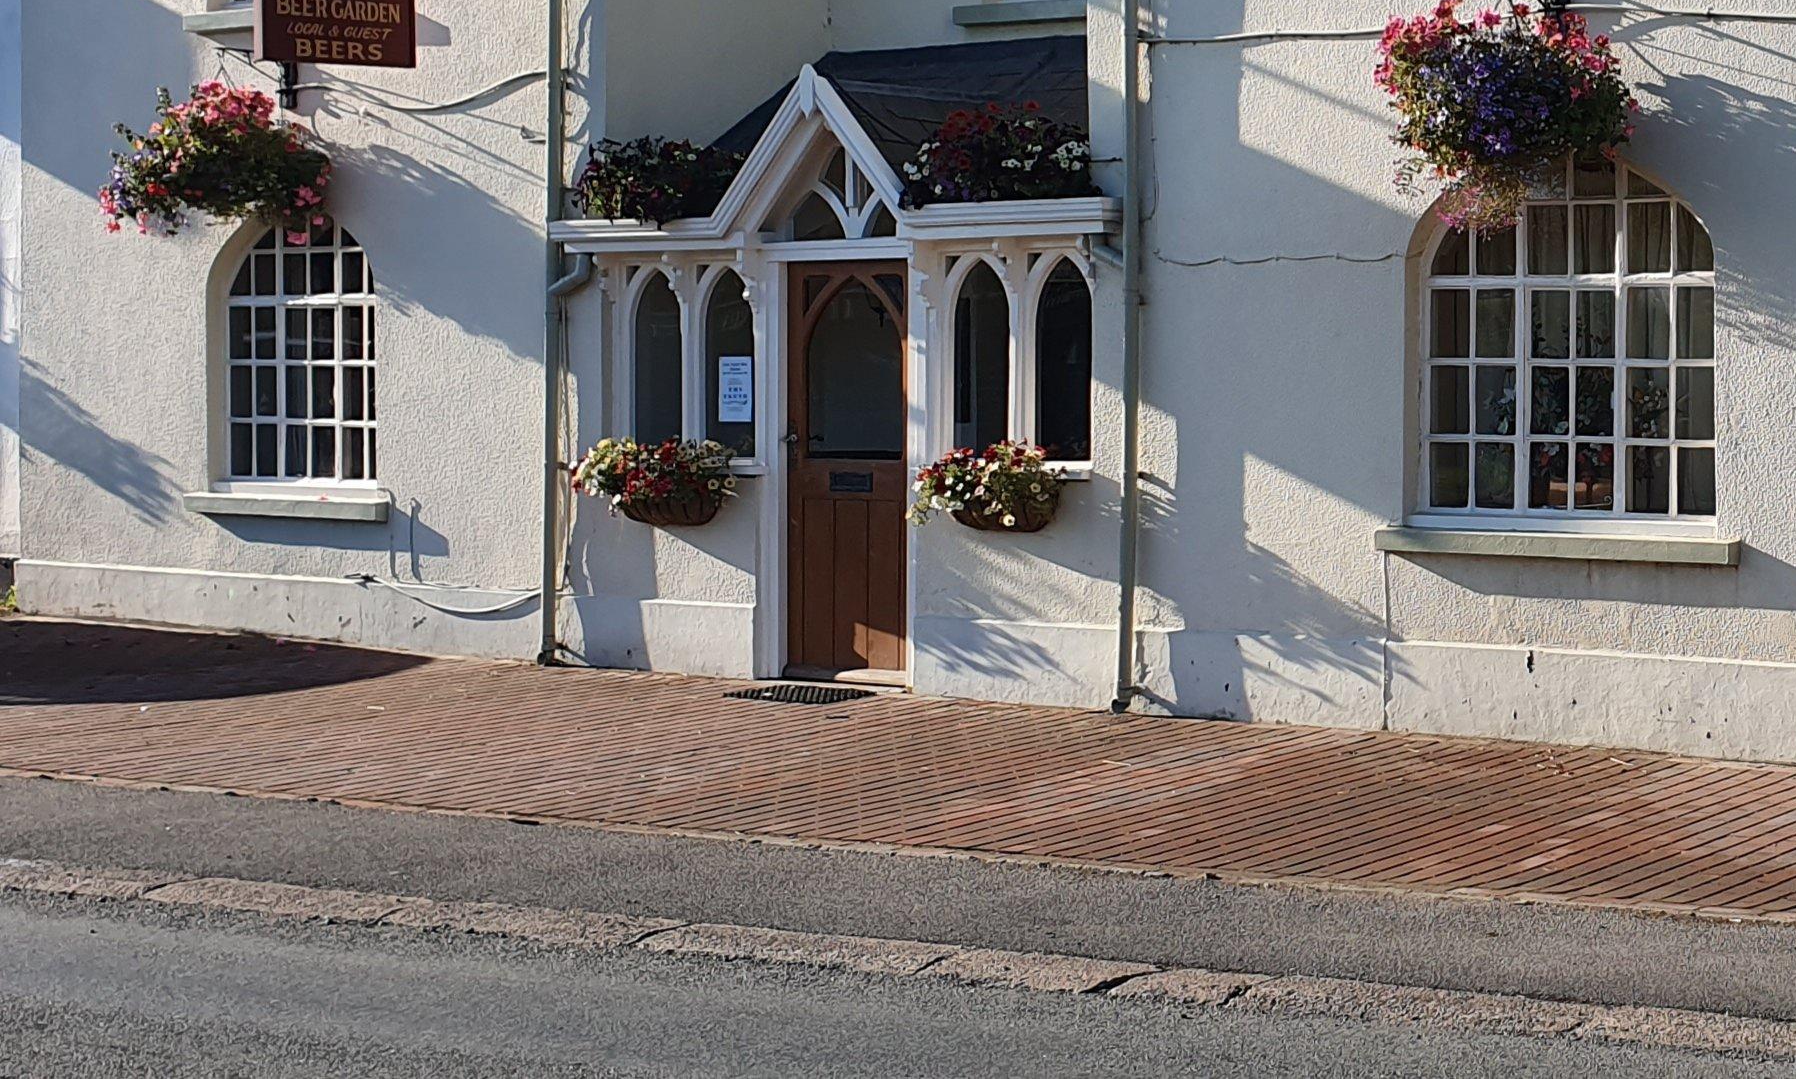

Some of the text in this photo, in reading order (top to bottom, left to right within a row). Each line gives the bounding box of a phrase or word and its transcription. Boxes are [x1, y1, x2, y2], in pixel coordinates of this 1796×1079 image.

[331, 0, 401, 23] GARDEN
[287, 22, 392, 40] LOCAL & GUEST
[295, 39, 383, 60] BEERS
